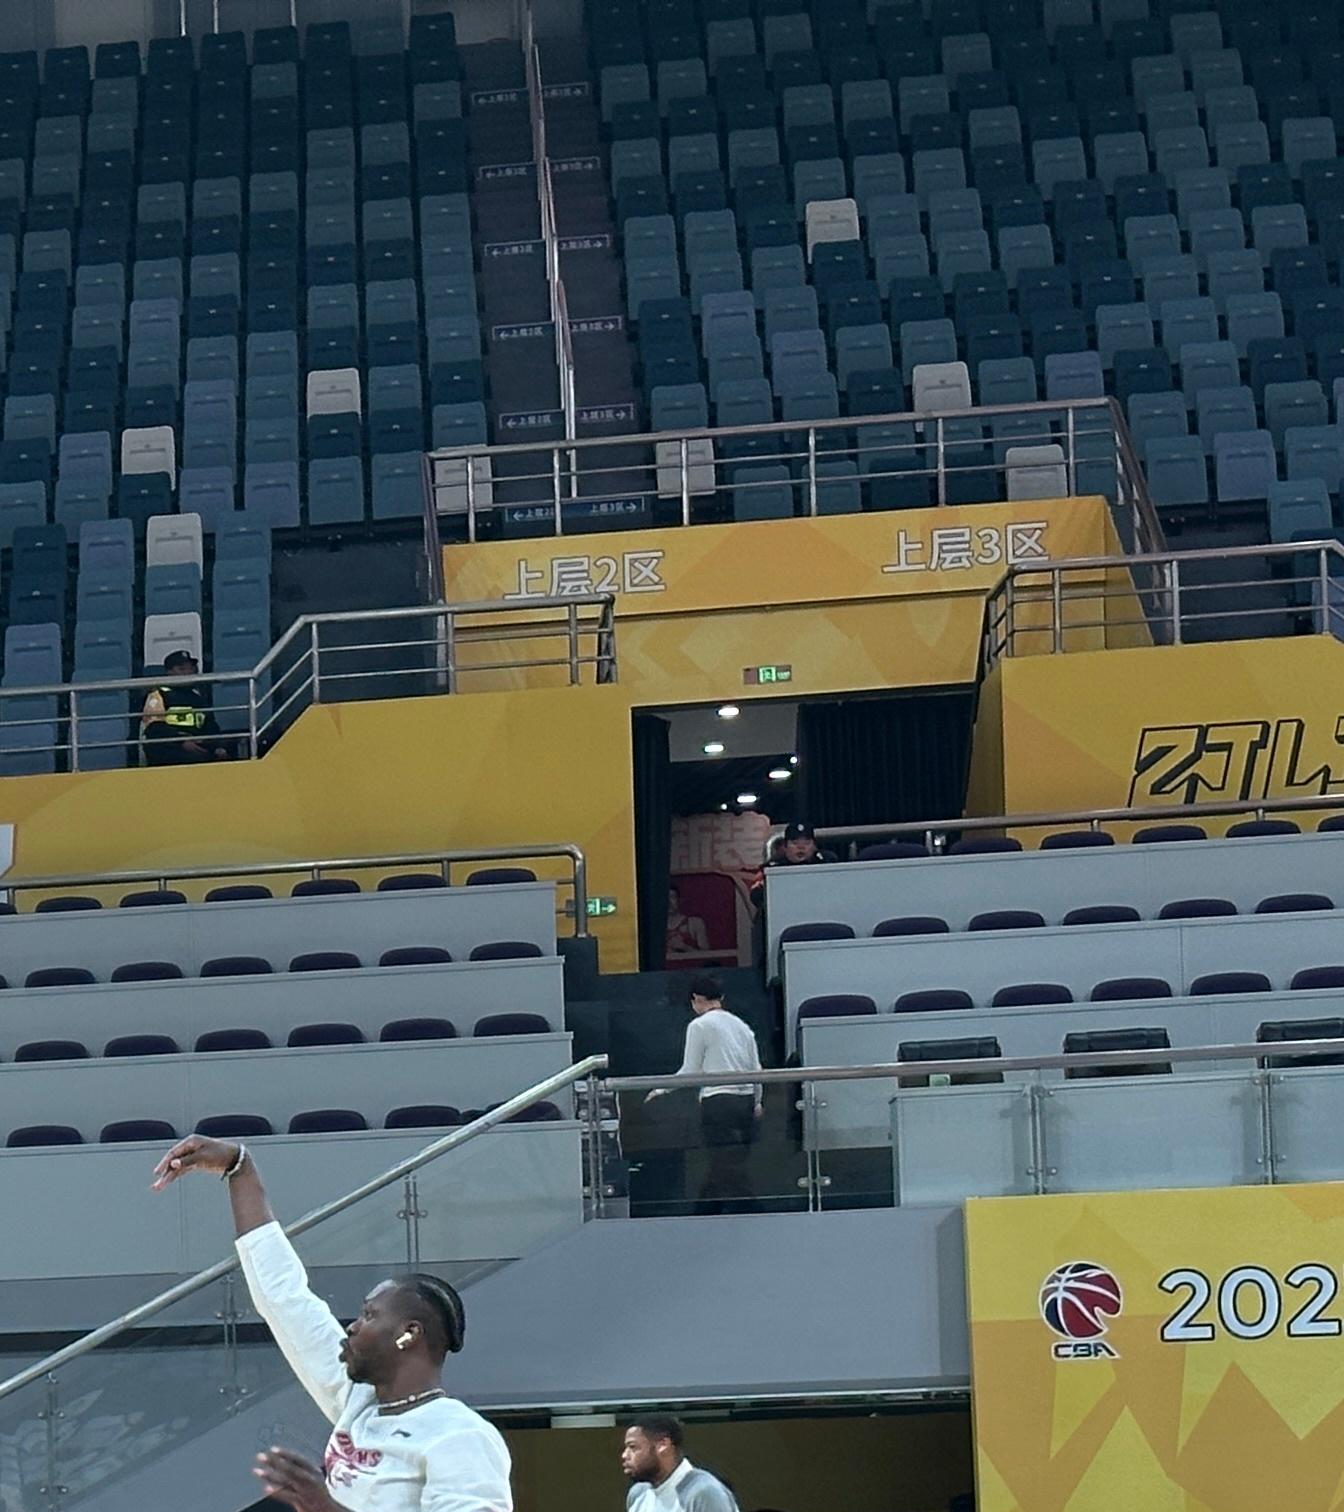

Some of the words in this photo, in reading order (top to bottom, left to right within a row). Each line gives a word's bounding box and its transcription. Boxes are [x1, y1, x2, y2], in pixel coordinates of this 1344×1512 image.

[880, 520, 1051, 574] 上层3区
[503, 549, 666, 601] 上层2区
[1158, 1262, 1344, 1342] 202
[1053, 1340, 1119, 1359] CBA
